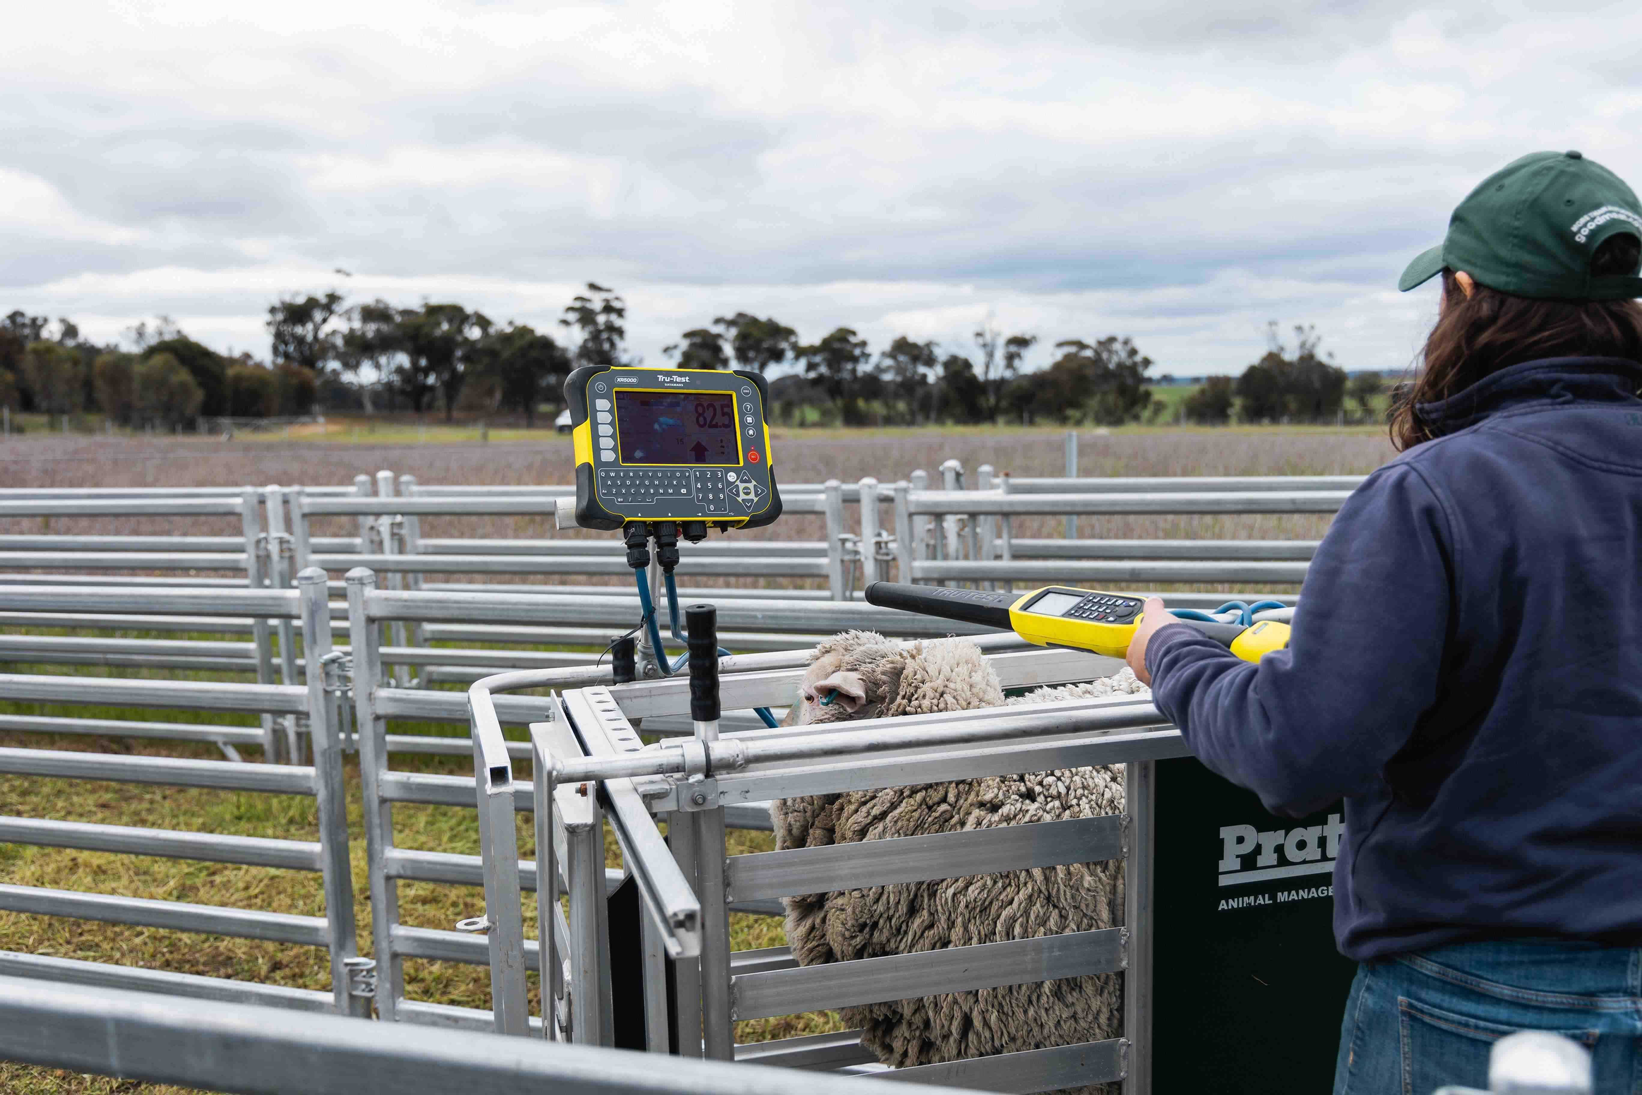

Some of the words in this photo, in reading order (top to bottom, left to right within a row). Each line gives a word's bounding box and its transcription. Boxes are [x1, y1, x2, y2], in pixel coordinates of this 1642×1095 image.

[656, 374, 690, 382] Tru-Test
[694, 402, 732, 428] 82.5
[1218, 813, 1345, 872] Prat
[1218, 894, 1272, 910] ANIMAL
